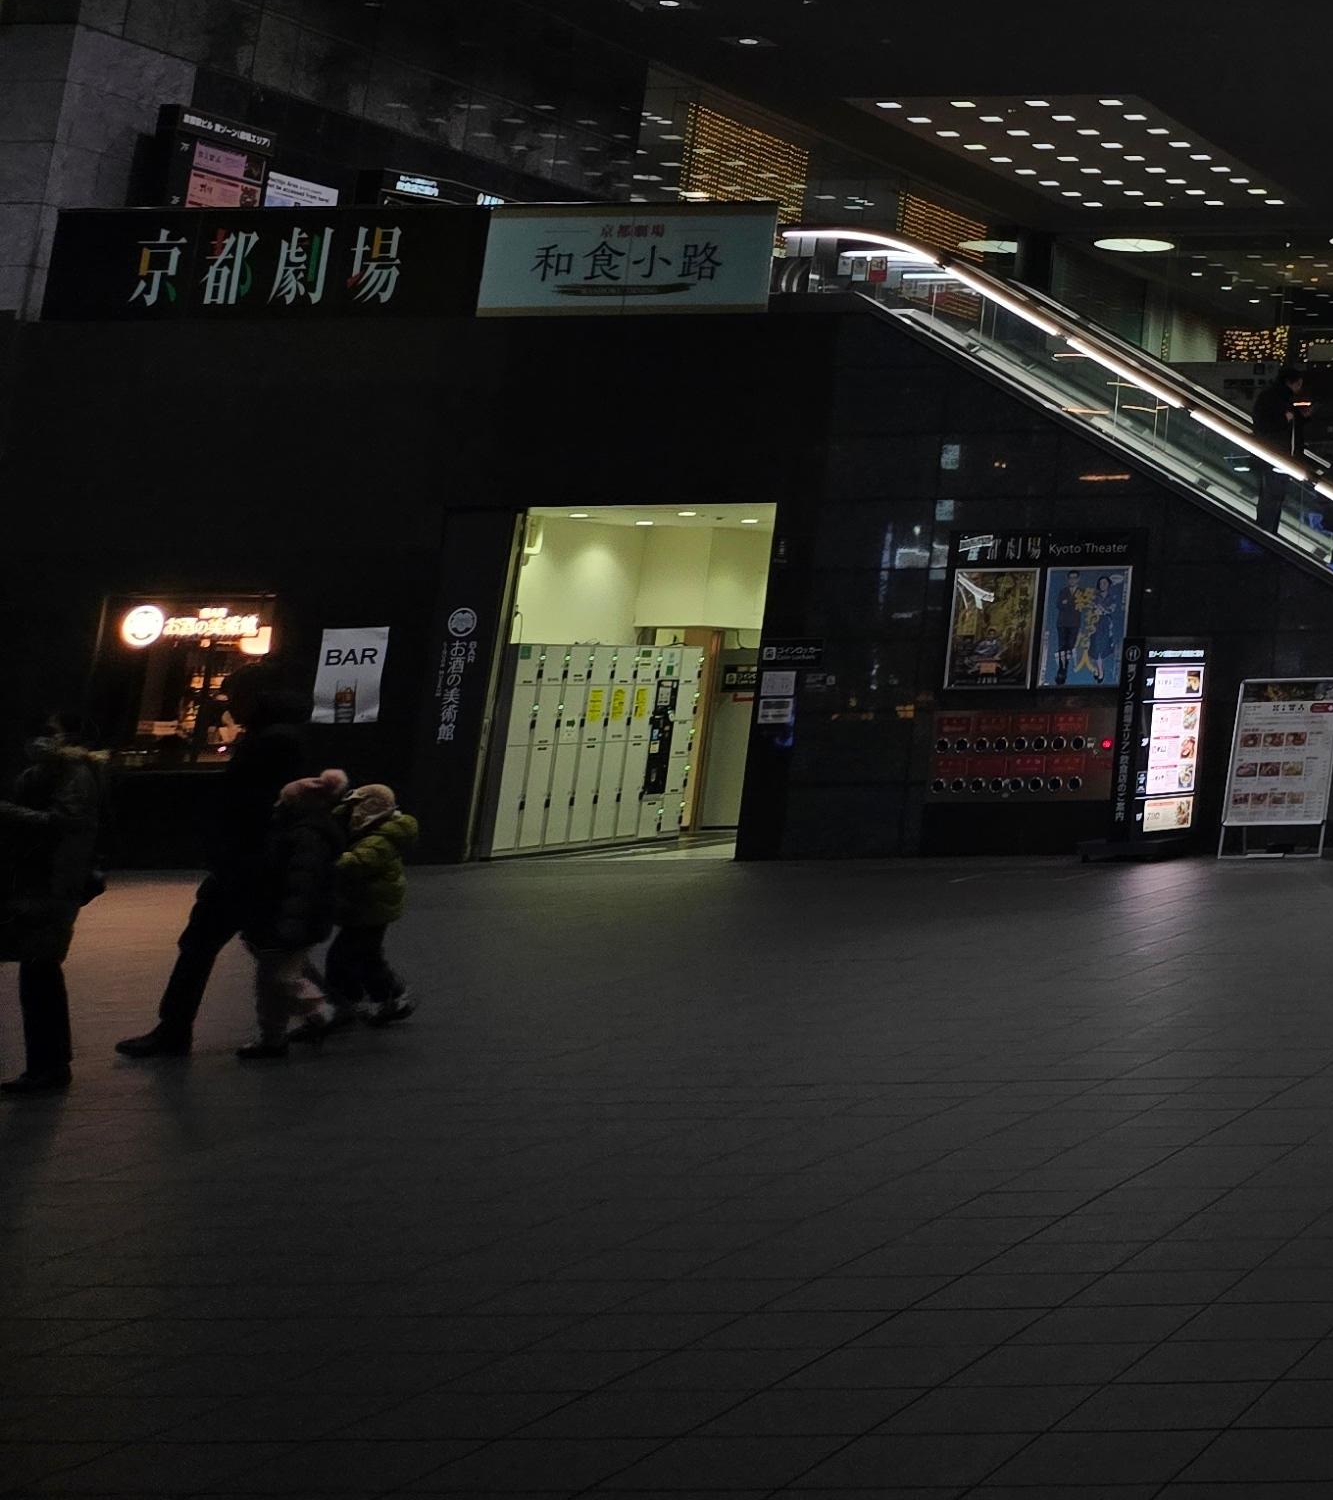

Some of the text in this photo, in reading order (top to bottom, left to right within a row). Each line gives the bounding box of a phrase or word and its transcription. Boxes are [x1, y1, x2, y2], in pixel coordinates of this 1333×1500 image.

[601, 224, 666, 238] 京都劇場
[127, 226, 402, 306] 京都劇場
[529, 241, 723, 282] 和食小路
[1049, 543, 1082, 556] Kyoto
[1085, 542, 1129, 555] Theater
[325, 648, 378, 666] BAR
[437, 640, 468, 740] お酒の美術館
